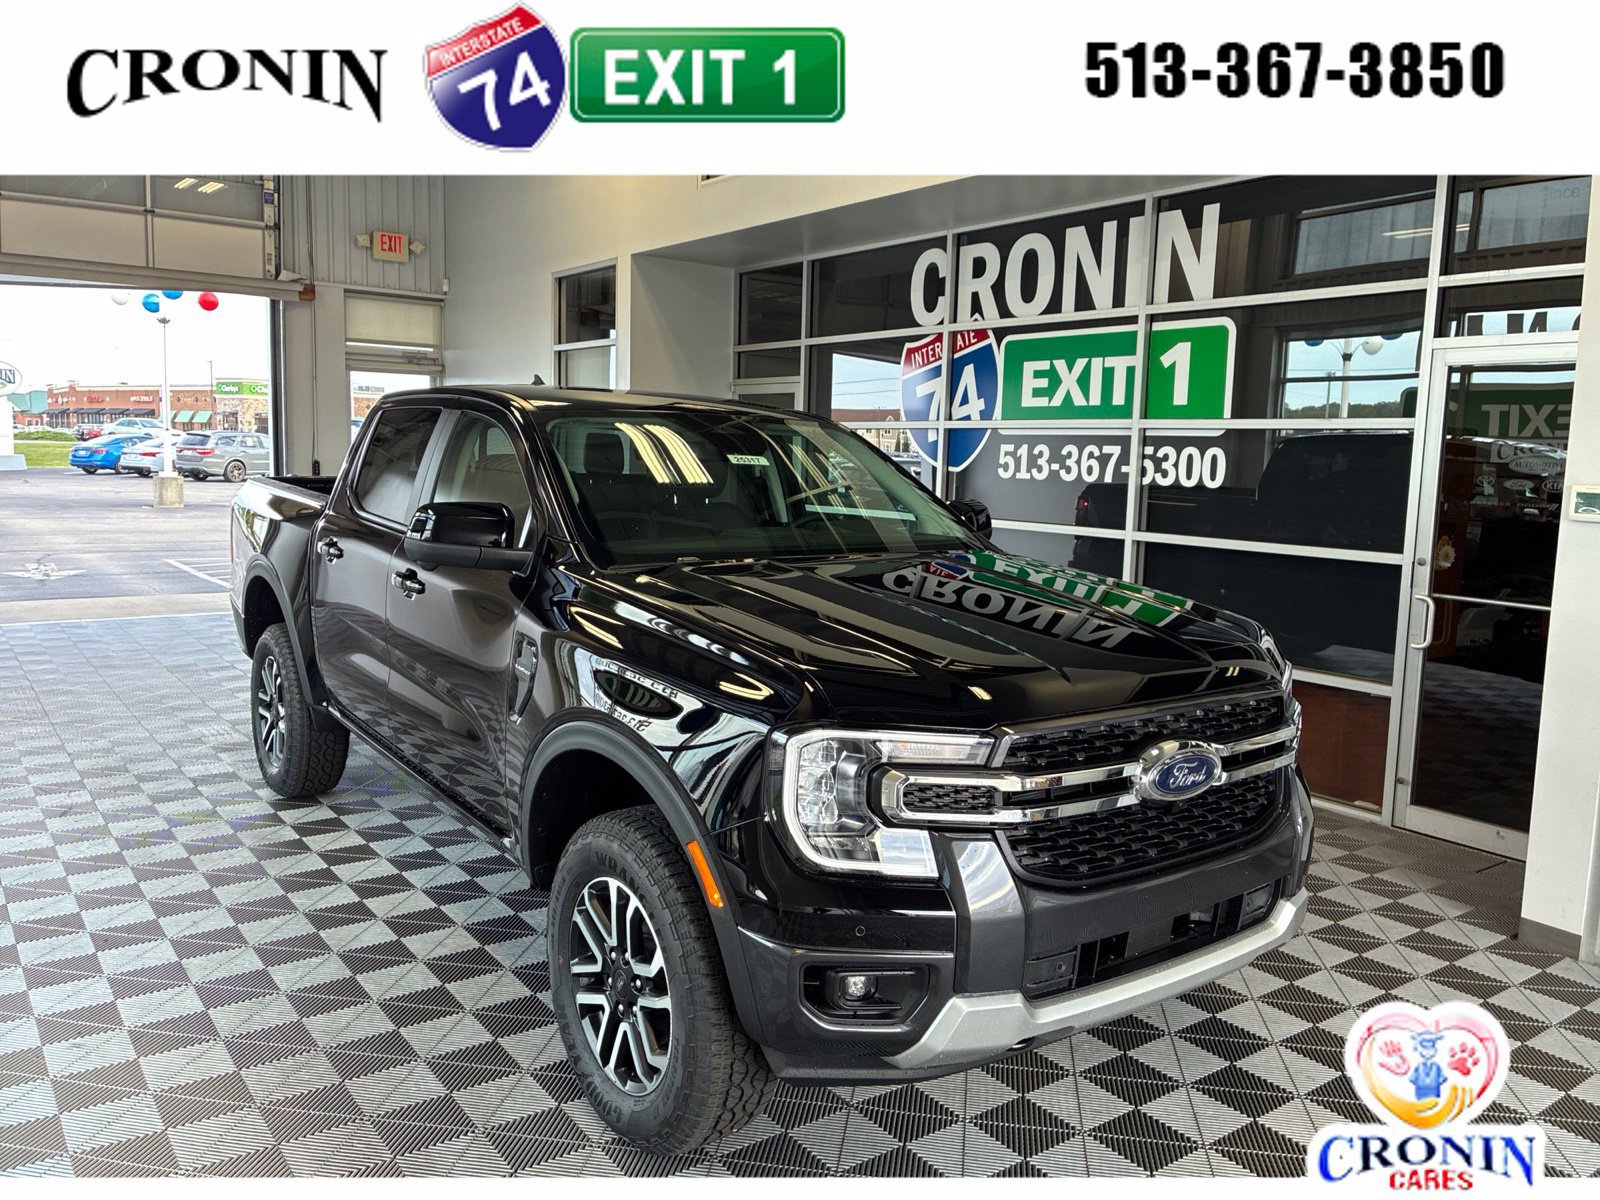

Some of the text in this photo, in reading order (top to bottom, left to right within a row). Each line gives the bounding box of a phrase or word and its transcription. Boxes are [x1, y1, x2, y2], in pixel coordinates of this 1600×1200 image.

[380, 233, 404, 255] EXIT
[910, 202, 1221, 327] CRONIN
[911, 330, 978, 369] INTERATE
[1021, 341, 1192, 408] EXIT 1
[915, 363, 986, 443] 74
[1170, 761, 1207, 788] Ford
